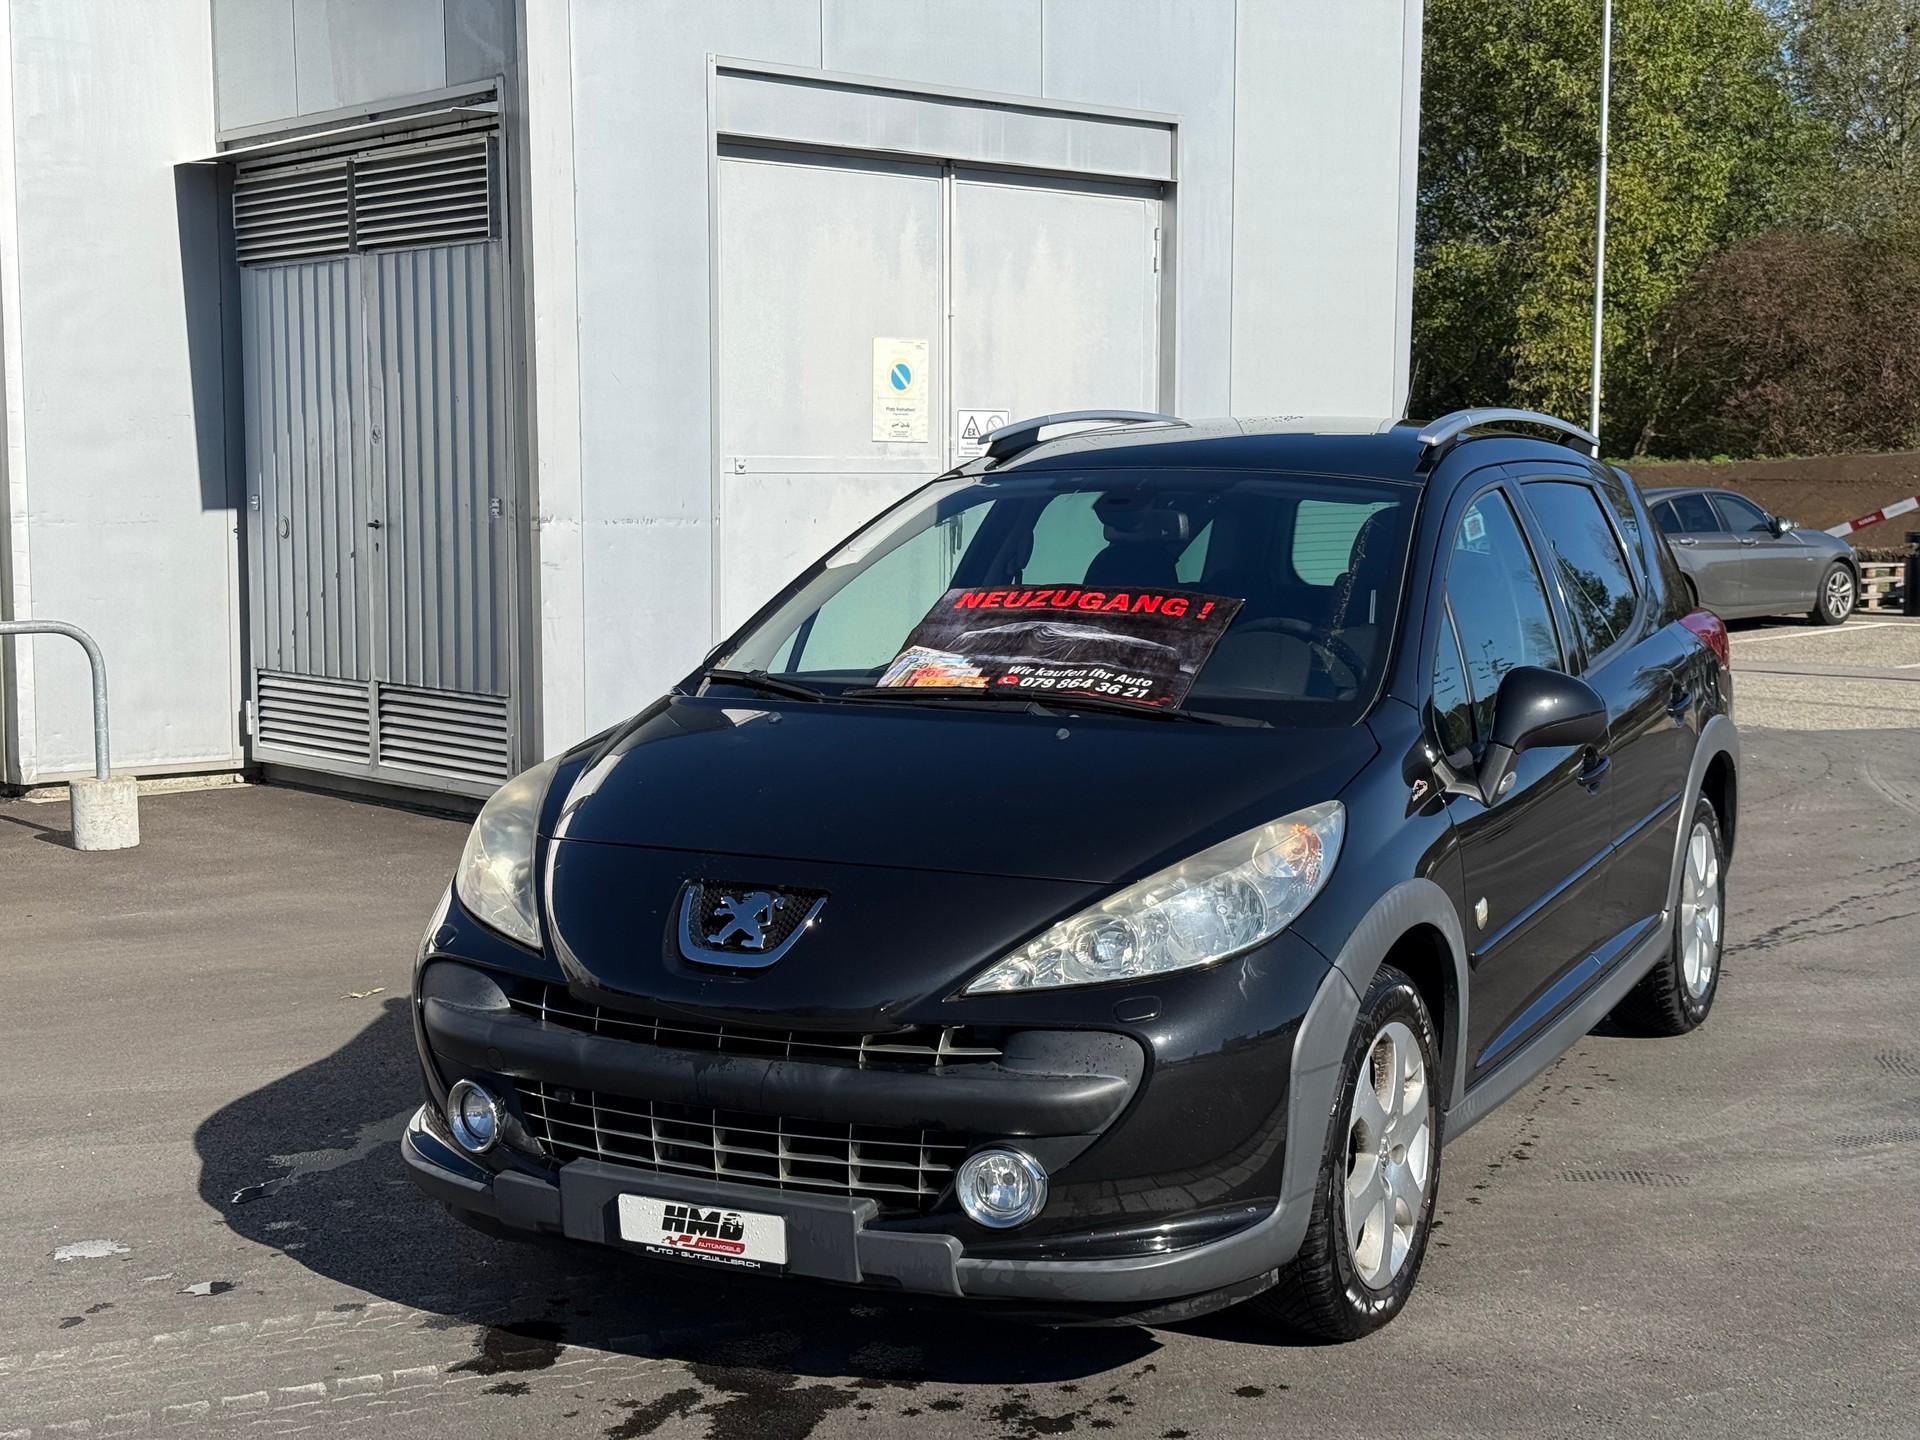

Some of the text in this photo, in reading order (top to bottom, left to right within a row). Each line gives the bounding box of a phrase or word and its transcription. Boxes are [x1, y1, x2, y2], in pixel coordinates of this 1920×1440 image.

[967, 428, 976, 436] EX
[954, 590, 1214, 620] NEUZUGANG !
[1007, 666, 1153, 687] Wir kaufen Ihr Auto
[1019, 677, 1149, 698] 079 864 36 21
[646, 1245, 674, 1256] AUTO
[681, 1251, 761, 1269] GUTZWILLER.CH
[698, 1241, 742, 1253] AUTOMOBILE
